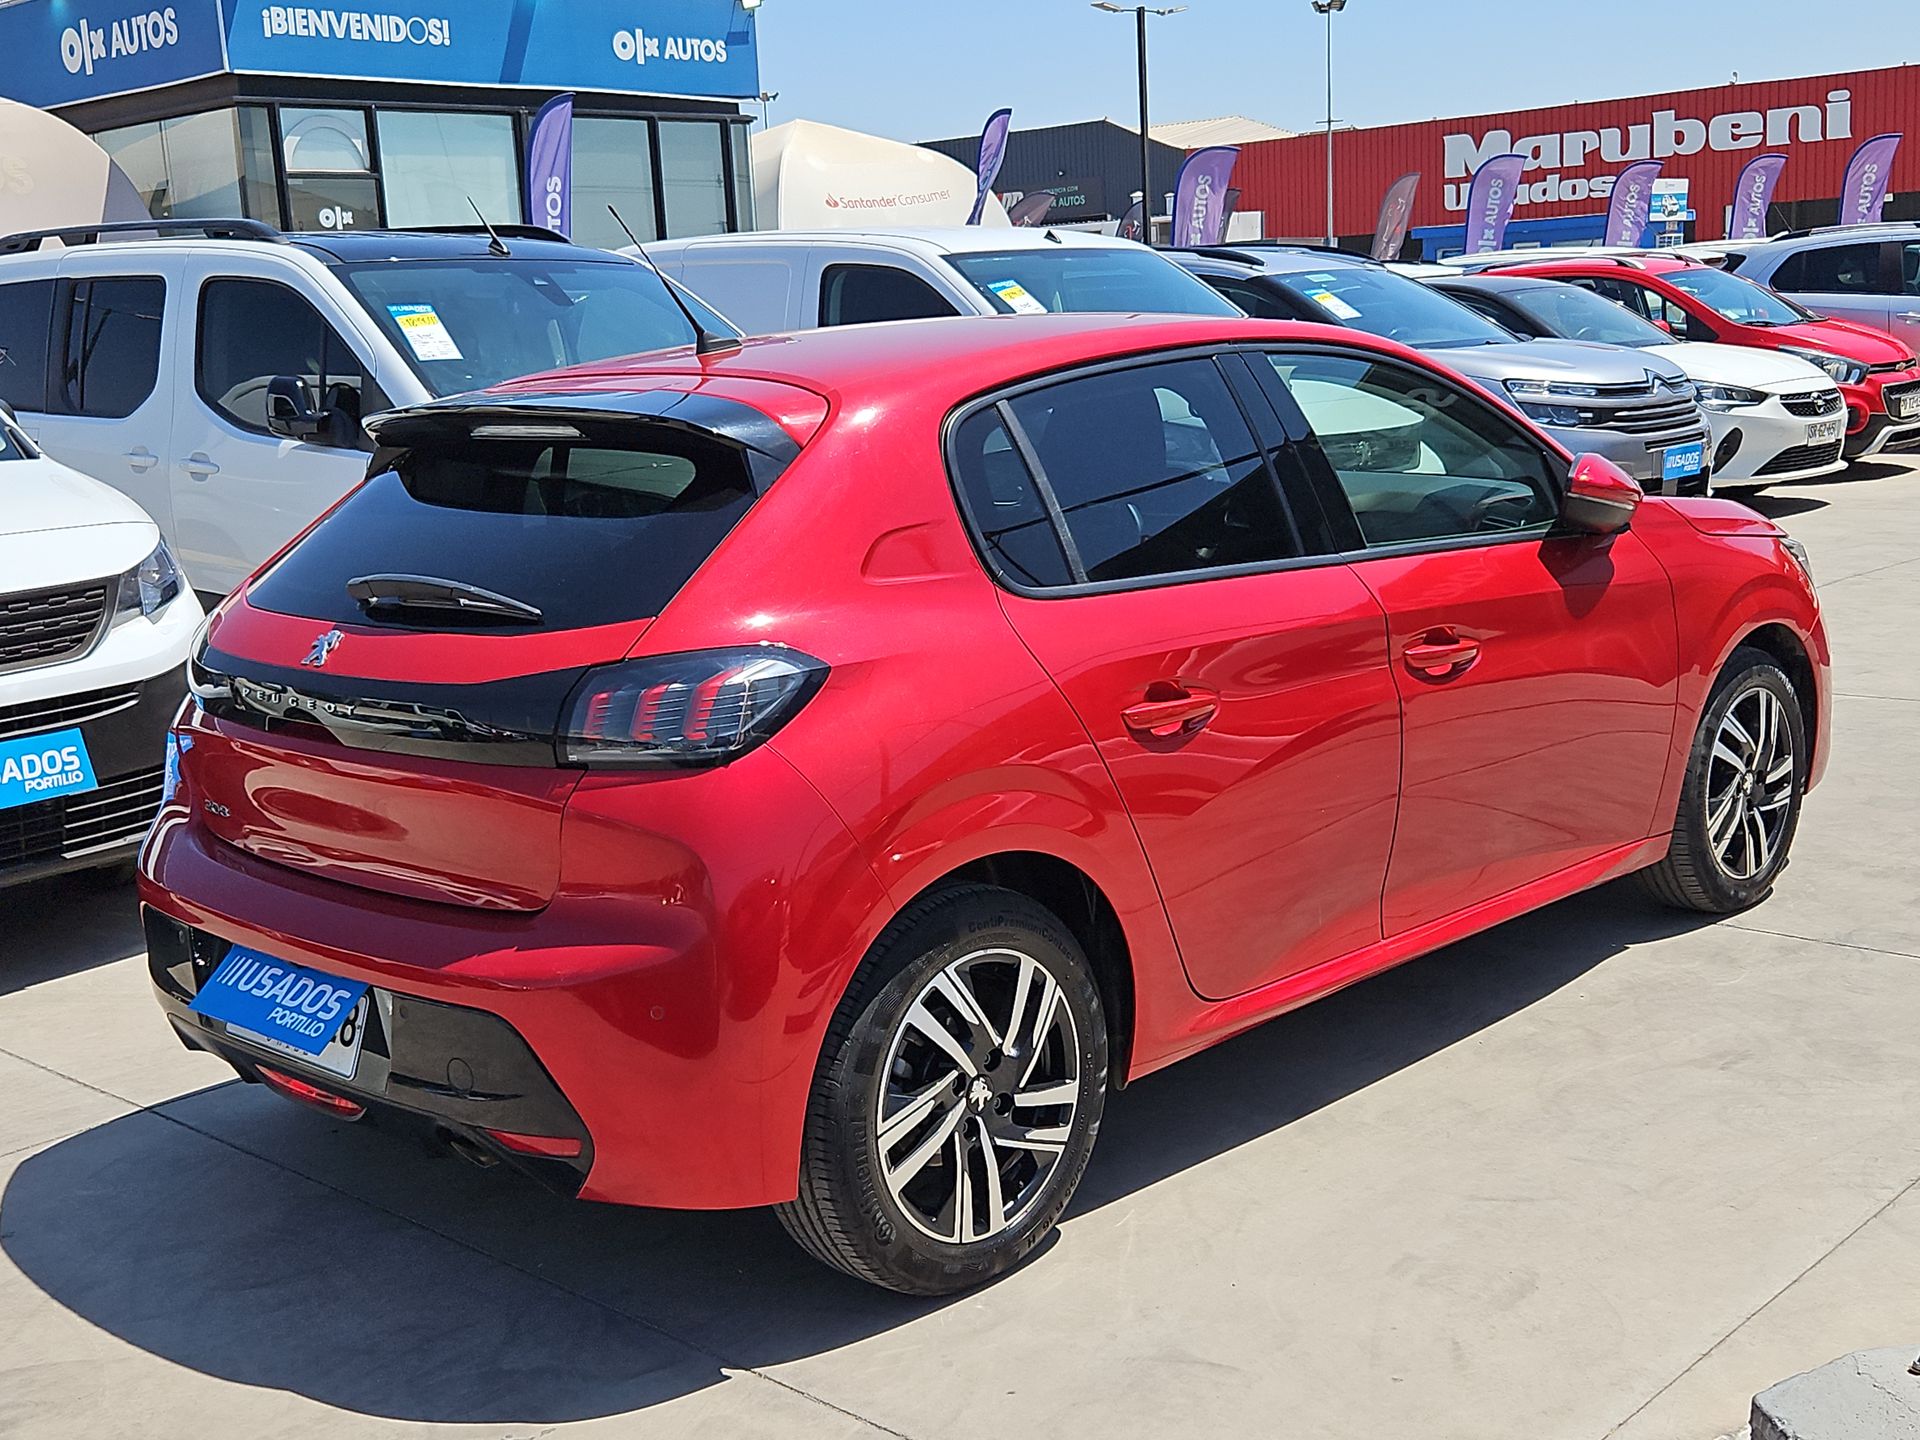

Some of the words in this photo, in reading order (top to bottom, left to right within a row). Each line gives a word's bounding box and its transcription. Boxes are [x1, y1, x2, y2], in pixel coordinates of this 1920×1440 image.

[111, 7, 178, 58] AUTOS
[261, 6, 451, 47] ¡BIENVENIDOS!
[664, 37, 727, 63] AUTOS
[1443, 89, 1853, 179] Marubeni
[546, 176, 562, 233] TOS
[839, 196, 897, 209] Santander
[897, 189, 951, 207] Consumer
[1059, 194, 1086, 207] AUTOS
[1192, 174, 1212, 229] AUTOS
[1444, 174, 1617, 211] udos
[1484, 178, 1504, 226] AUTOS
[1622, 184, 1640, 228] AUTOS
[1749, 175, 1767, 216] AUTOS
[1858, 163, 1878, 215] AUTOS
[1672, 452, 1700, 468] USADOS
[242, 687, 355, 716] PEUGEOT
[0, 746, 81, 785] ADOS
[25, 772, 84, 793] PORTILLO
[237, 961, 352, 1021] USADOS
[266, 1006, 326, 1038] PORTILLO
